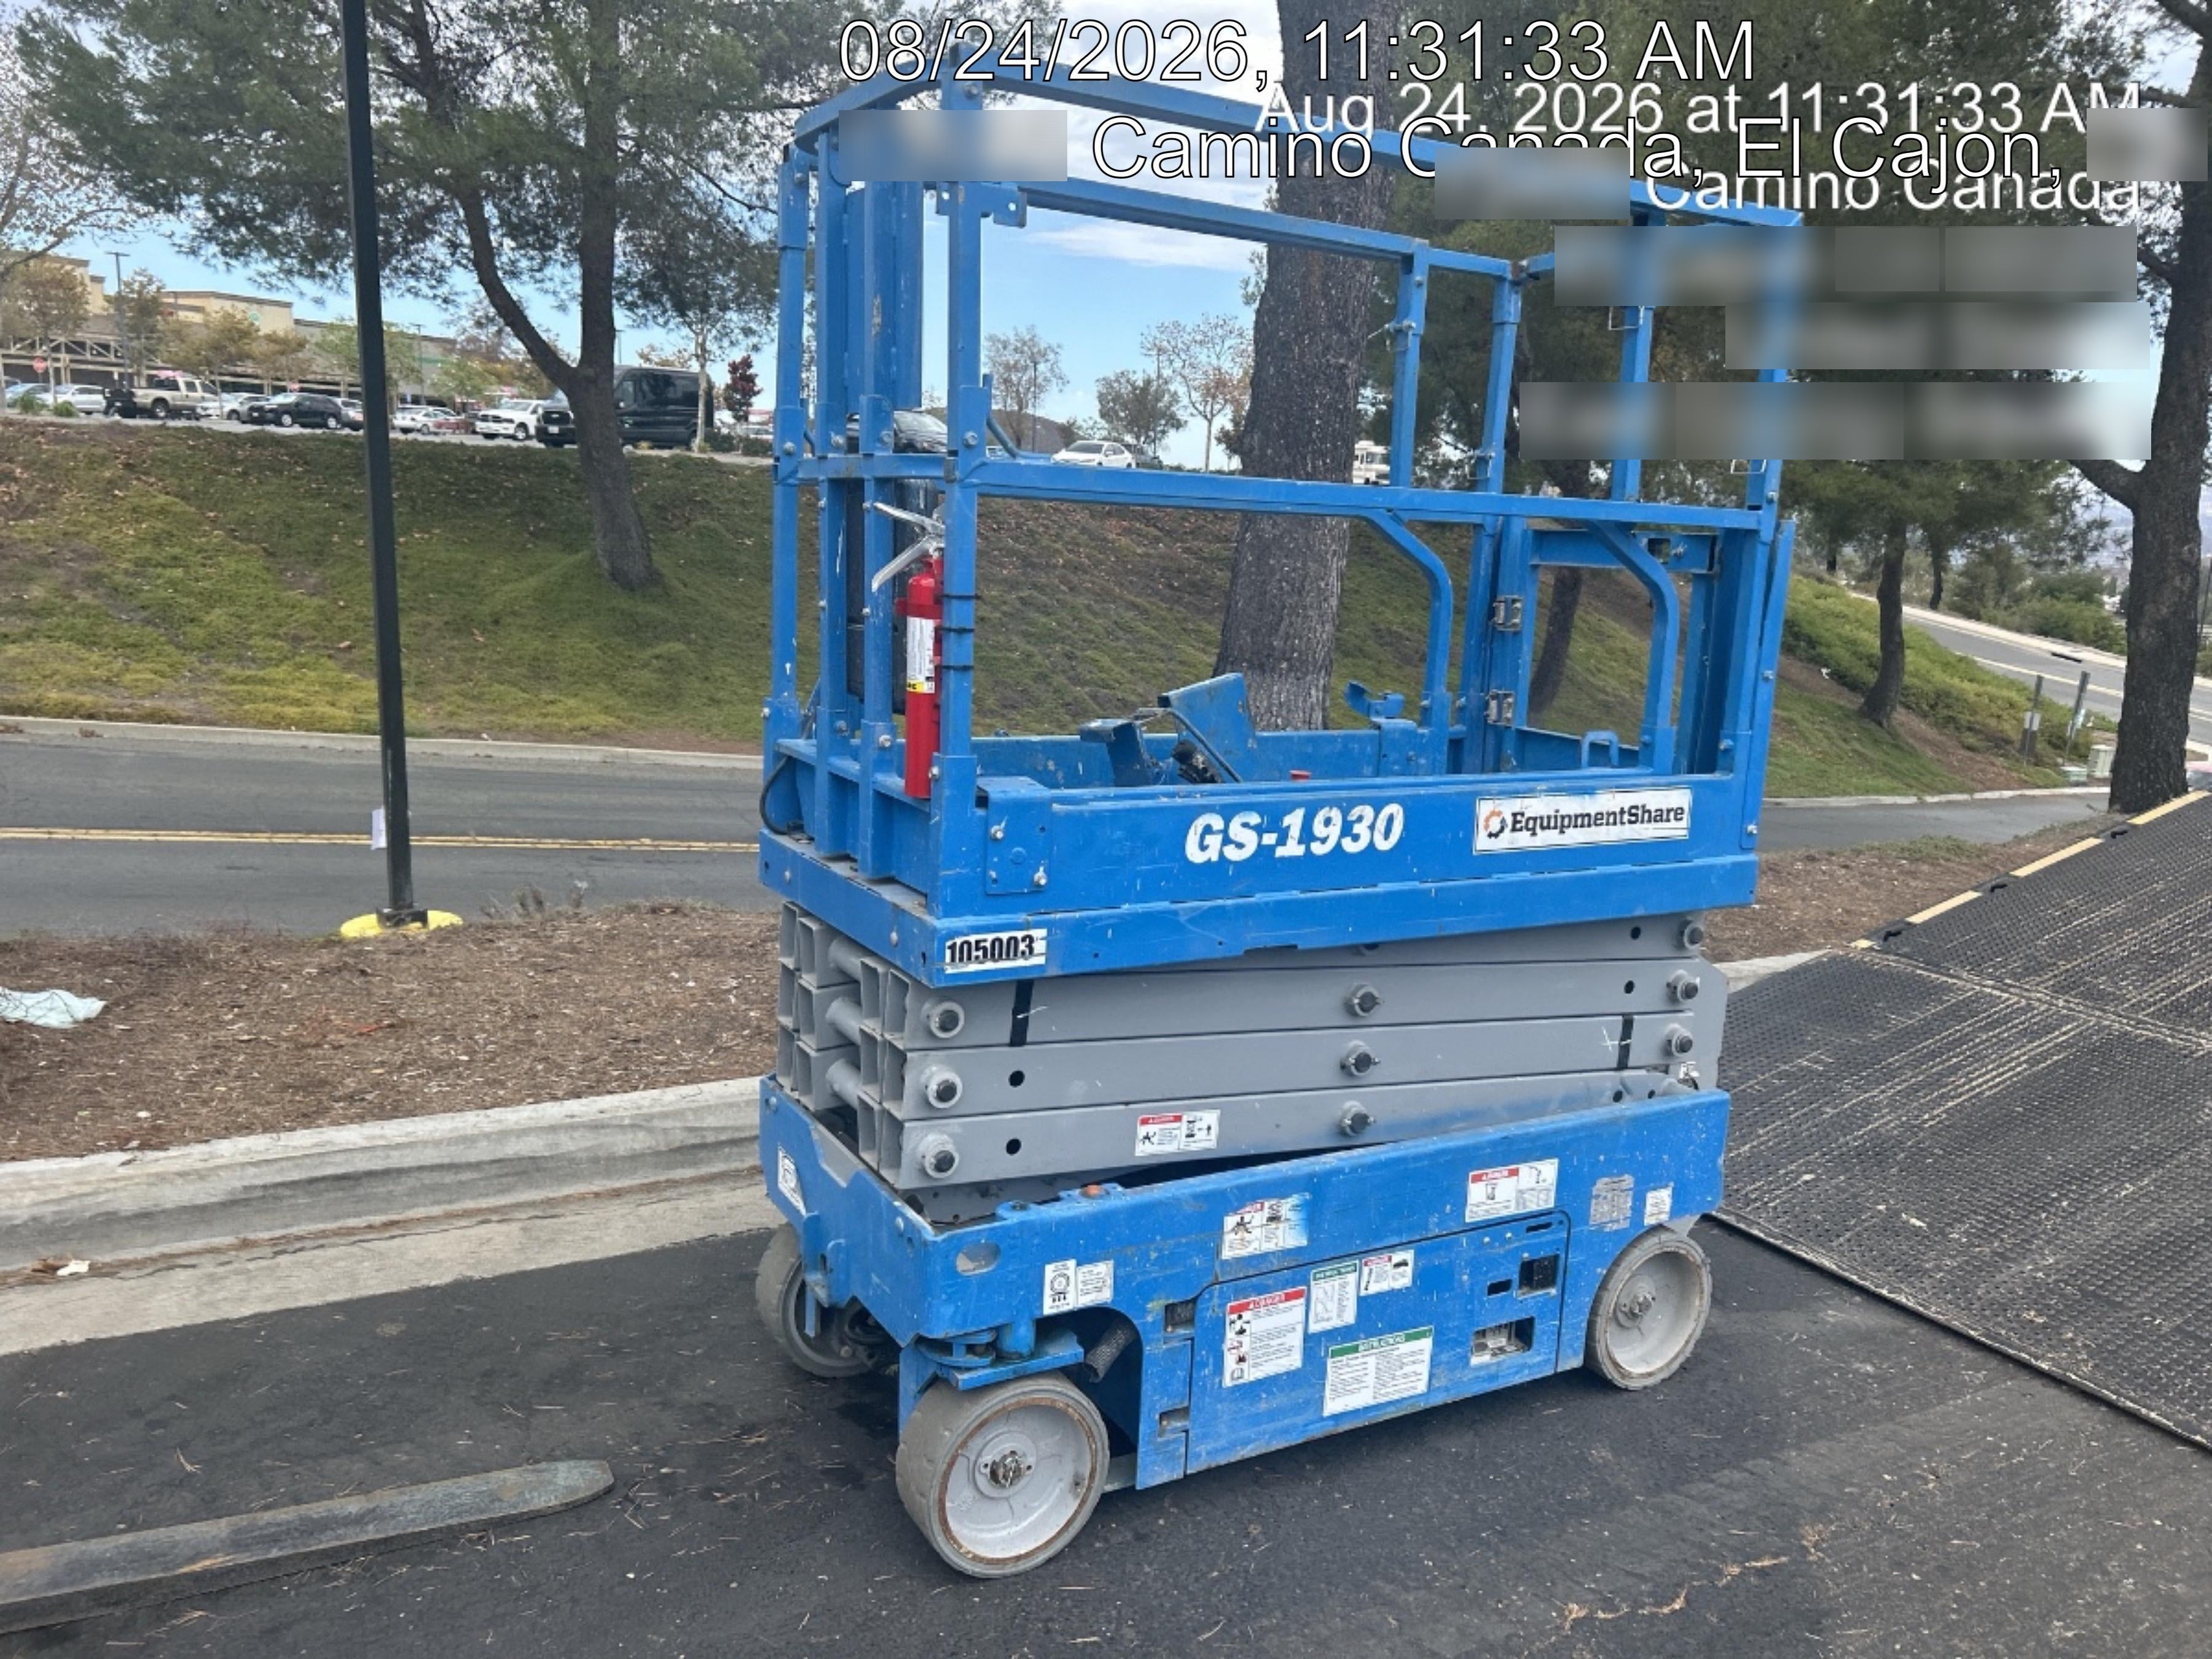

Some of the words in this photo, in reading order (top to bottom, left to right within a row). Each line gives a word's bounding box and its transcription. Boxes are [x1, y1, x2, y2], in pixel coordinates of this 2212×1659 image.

[1185, 802, 1404, 864] GS-1930
[1509, 804, 1685, 837] EquipmentShare
[947, 934, 1035, 964] 105003
